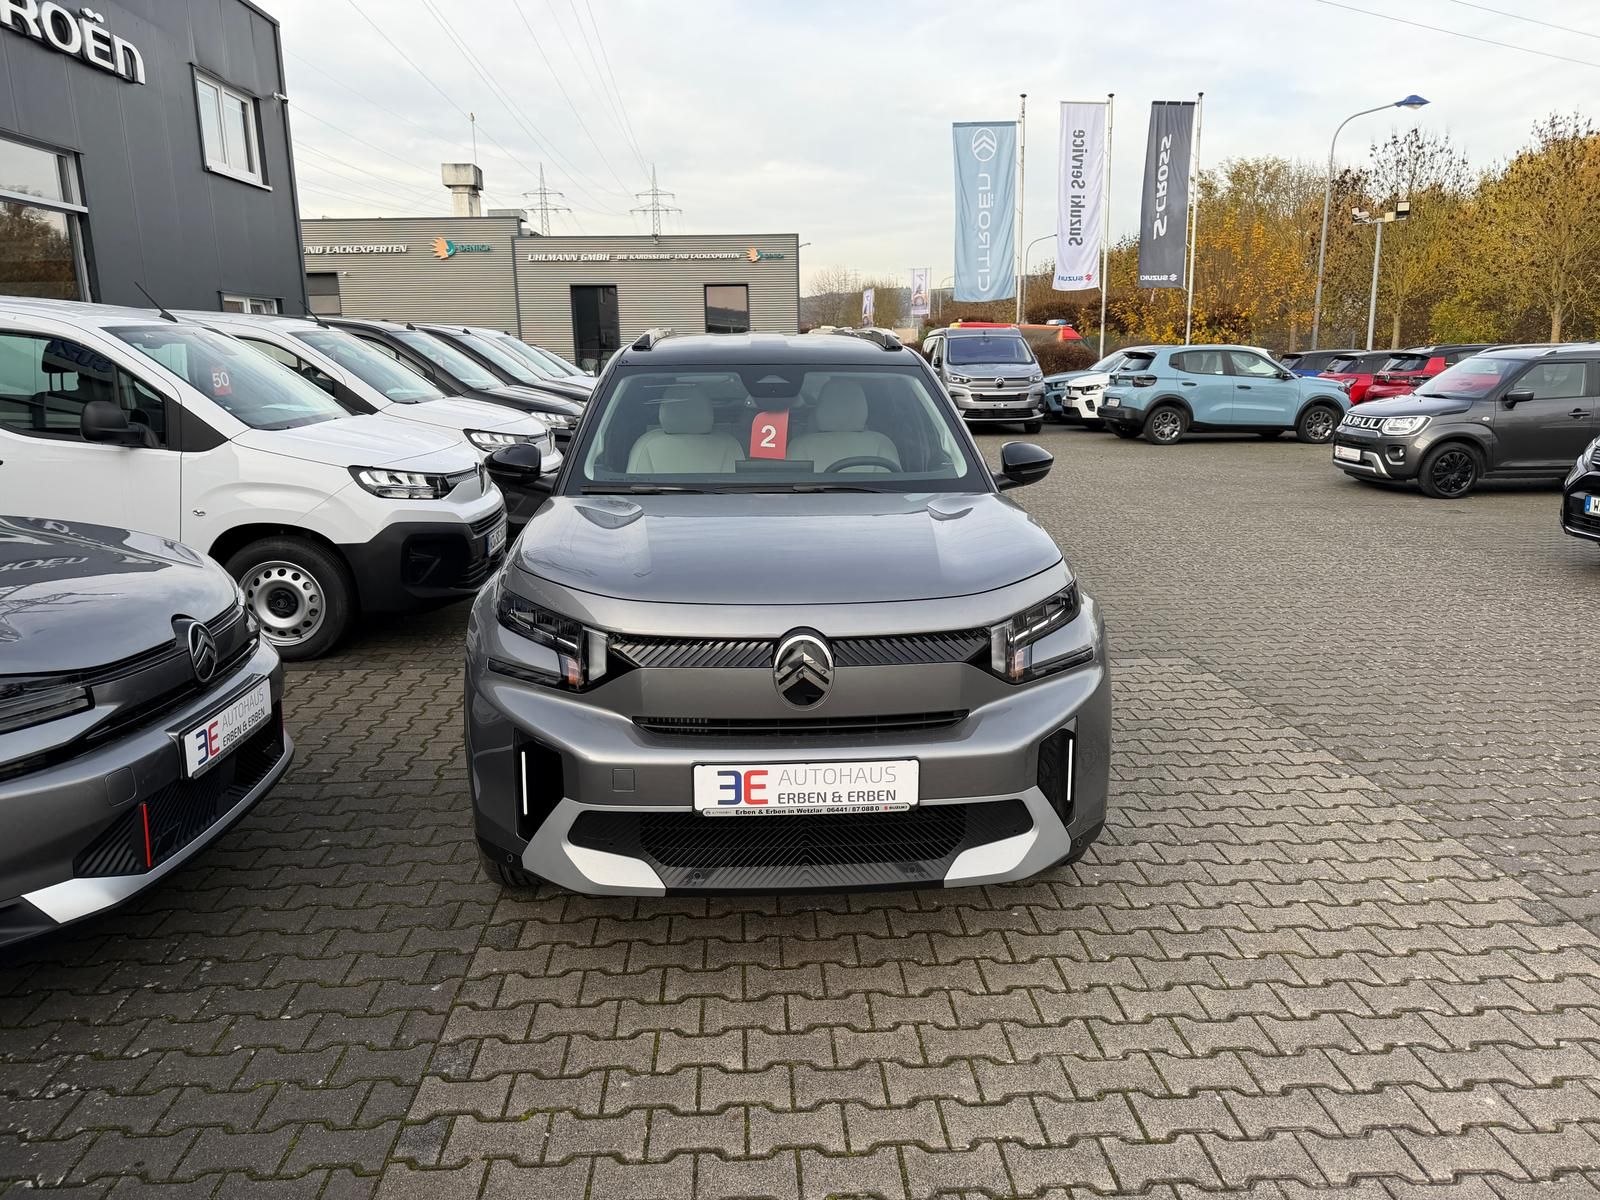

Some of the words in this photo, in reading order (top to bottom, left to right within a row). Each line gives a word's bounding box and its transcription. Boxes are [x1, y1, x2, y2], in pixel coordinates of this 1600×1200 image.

[325, 244, 408, 254] LACKEXPERTEN
[528, 253, 578, 262] UHLMANN
[212, 371, 230, 388] 50
[760, 424, 777, 448] 2
[222, 687, 264, 730] AUTOHAUS
[222, 724, 242, 747] ERBEN
[242, 720, 248, 731] &
[248, 706, 266, 727] ERBEN
[778, 766, 896, 786] AUTOHAUS
[778, 791, 828, 804] ERBEN
[831, 791, 843, 803] &
[848, 789, 896, 802] ERBEN
[797, 806, 823, 814] Wetzlar
